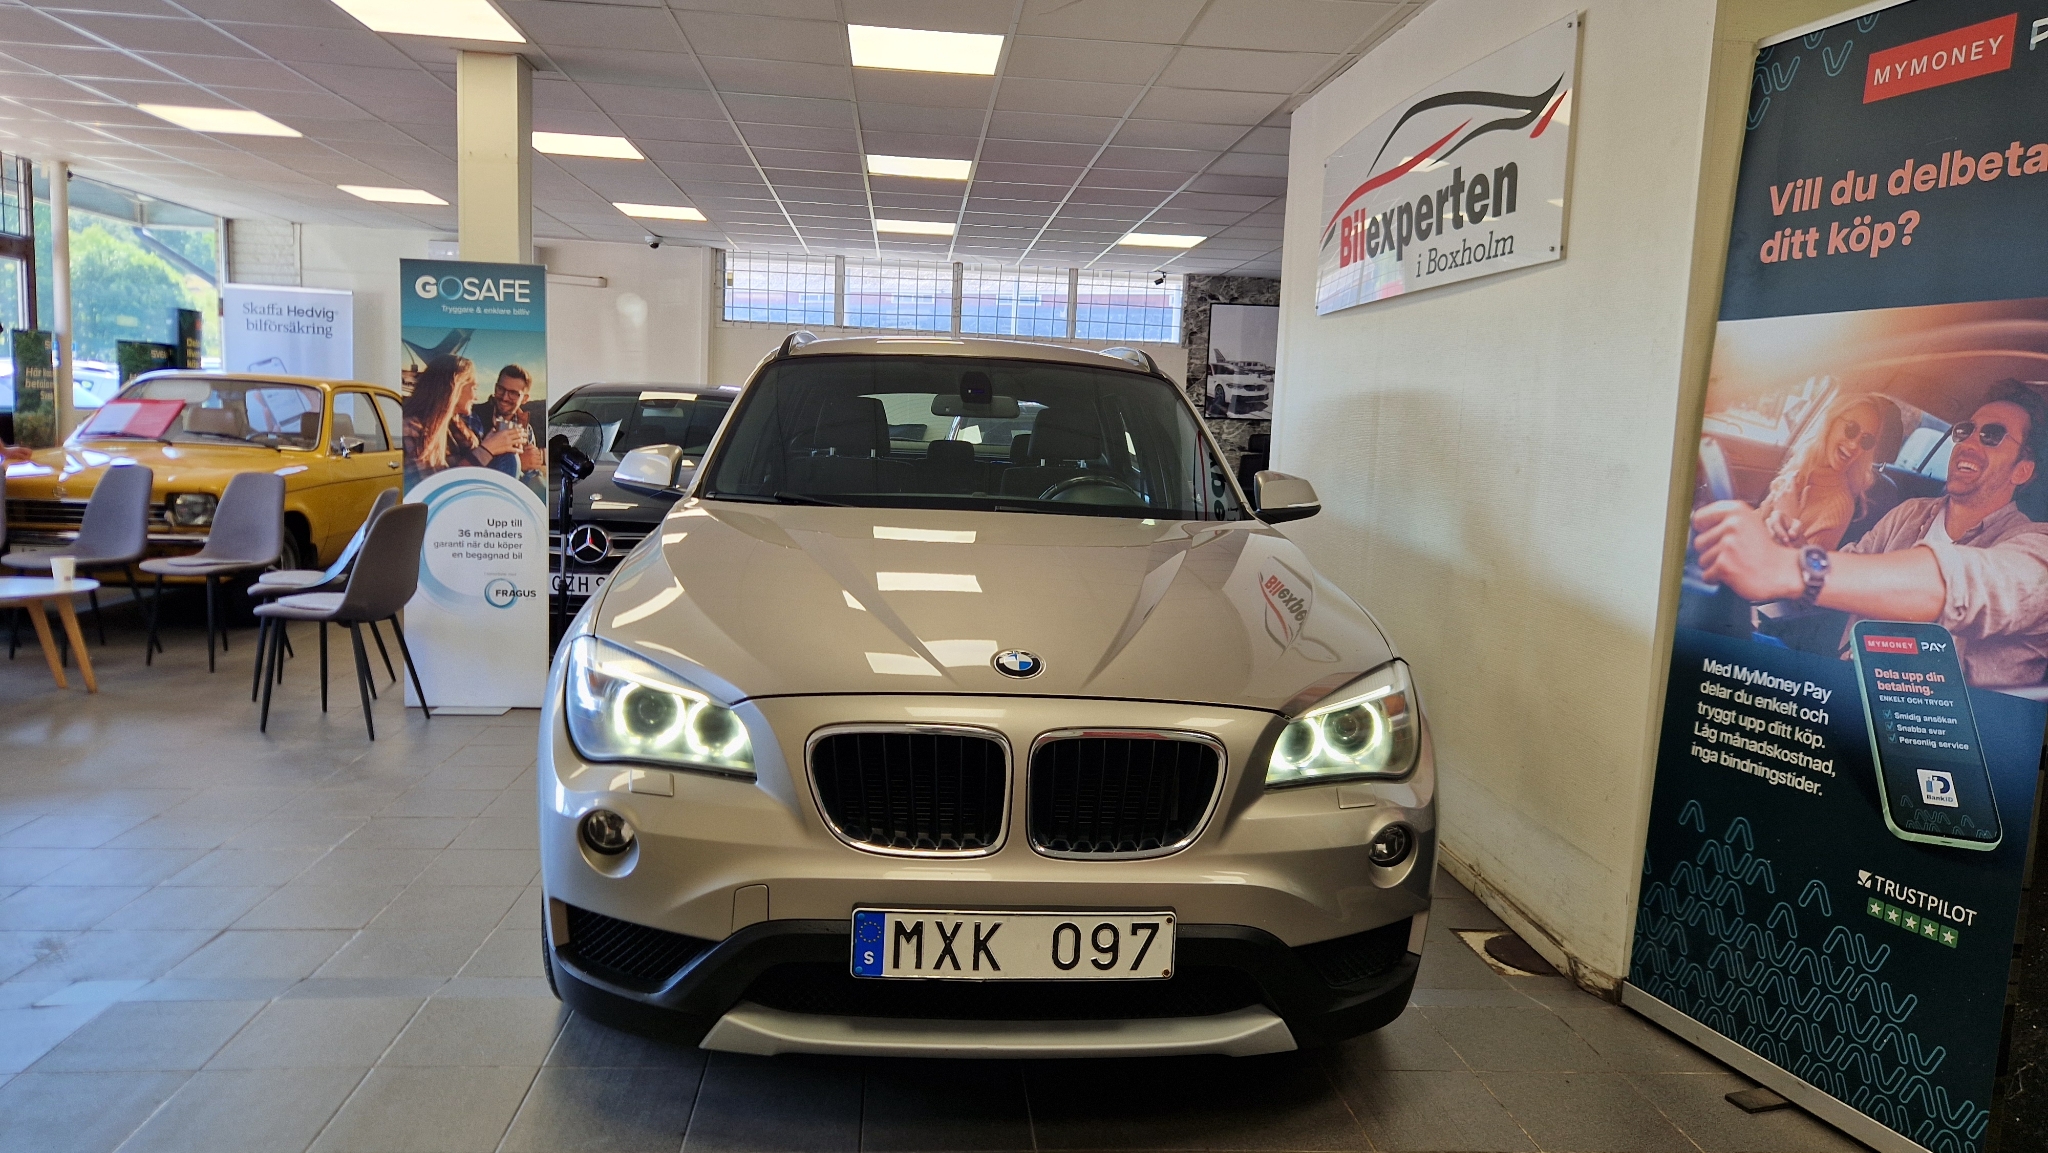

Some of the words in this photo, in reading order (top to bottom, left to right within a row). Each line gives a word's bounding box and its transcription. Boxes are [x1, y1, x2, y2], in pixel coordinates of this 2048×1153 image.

[1873, 34, 2005, 86] MYMONEY
[1769, 176, 1823, 216] Vill
[1830, 170, 1878, 206] du
[1886, 140, 2048, 196] delbeta
[1339, 161, 1518, 269] Bilexperten
[1759, 224, 1820, 264] ditt
[1827, 210, 1921, 259] köp?
[1415, 253, 1422, 278] i
[1425, 230, 1515, 276] Boxholm
[415, 275, 531, 303] GOSAFE
[242, 302, 283, 316] Skaffa
[287, 305, 335, 323] Hedvig
[441, 304, 474, 315] Tryggare
[476, 306, 482, 314] &
[484, 305, 511, 315] enklare
[246, 318, 333, 339] bilförsäkring
[487, 518, 508, 529] Upp
[511, 518, 522, 528] till
[457, 529, 471, 538] 36
[474, 529, 523, 539] månaders
[433, 540, 464, 550] garanti
[467, 541, 481, 549] när
[484, 541, 495, 549] du
[497, 540, 523, 551] köper
[466, 551, 510, 561] begagnad
[512, 551, 523, 560] bil
[495, 589, 537, 598] FRAGUS
[1867, 640, 1914, 650] MYMONEY
[1921, 641, 1947, 653] PAY
[1702, 657, 1733, 678] Med
[1732, 664, 1802, 697] MyMoney
[1802, 681, 1833, 705] Pay
[1874, 667, 1900, 680] Dela
[1901, 671, 1924, 683] upp
[1926, 671, 1945, 683] din
[1877, 680, 1934, 697] betalning.
[1700, 680, 1734, 700] delar
[1734, 689, 1753, 706] du
[1754, 695, 1799, 718] enkelt
[1799, 706, 1829, 726] och
[1879, 694, 1905, 704] ENKELT
[1907, 697, 1923, 705] OCH
[1924, 698, 1954, 707] TRYGGT
[1697, 701, 1737, 726] tryggt
[1738, 714, 1766, 734] upp
[1767, 720, 1793, 740] ditt
[1794, 726, 1826, 749] köp.
[1894, 711, 1922, 723] Smidig
[1923, 714, 1958, 725] ansökan
[1896, 723, 1927, 735] Snabba
[1928, 727, 1946, 736] svar
[1694, 721, 1718, 744] Låg
[1718, 731, 1836, 778] månadskostnad,
[1899, 736, 1937, 749] Personlig
[1938, 740, 1969, 751] service
[1691, 741, 1719, 763] inga
[1719, 750, 1823, 796] bindningstider.
[1926, 794, 1954, 803] BankID
[1874, 875, 1978, 927] TRUSTPILOT
[892, 919, 1003, 972] MXK
[1051, 921, 1161, 972] 097
[863, 950, 875, 966] S
